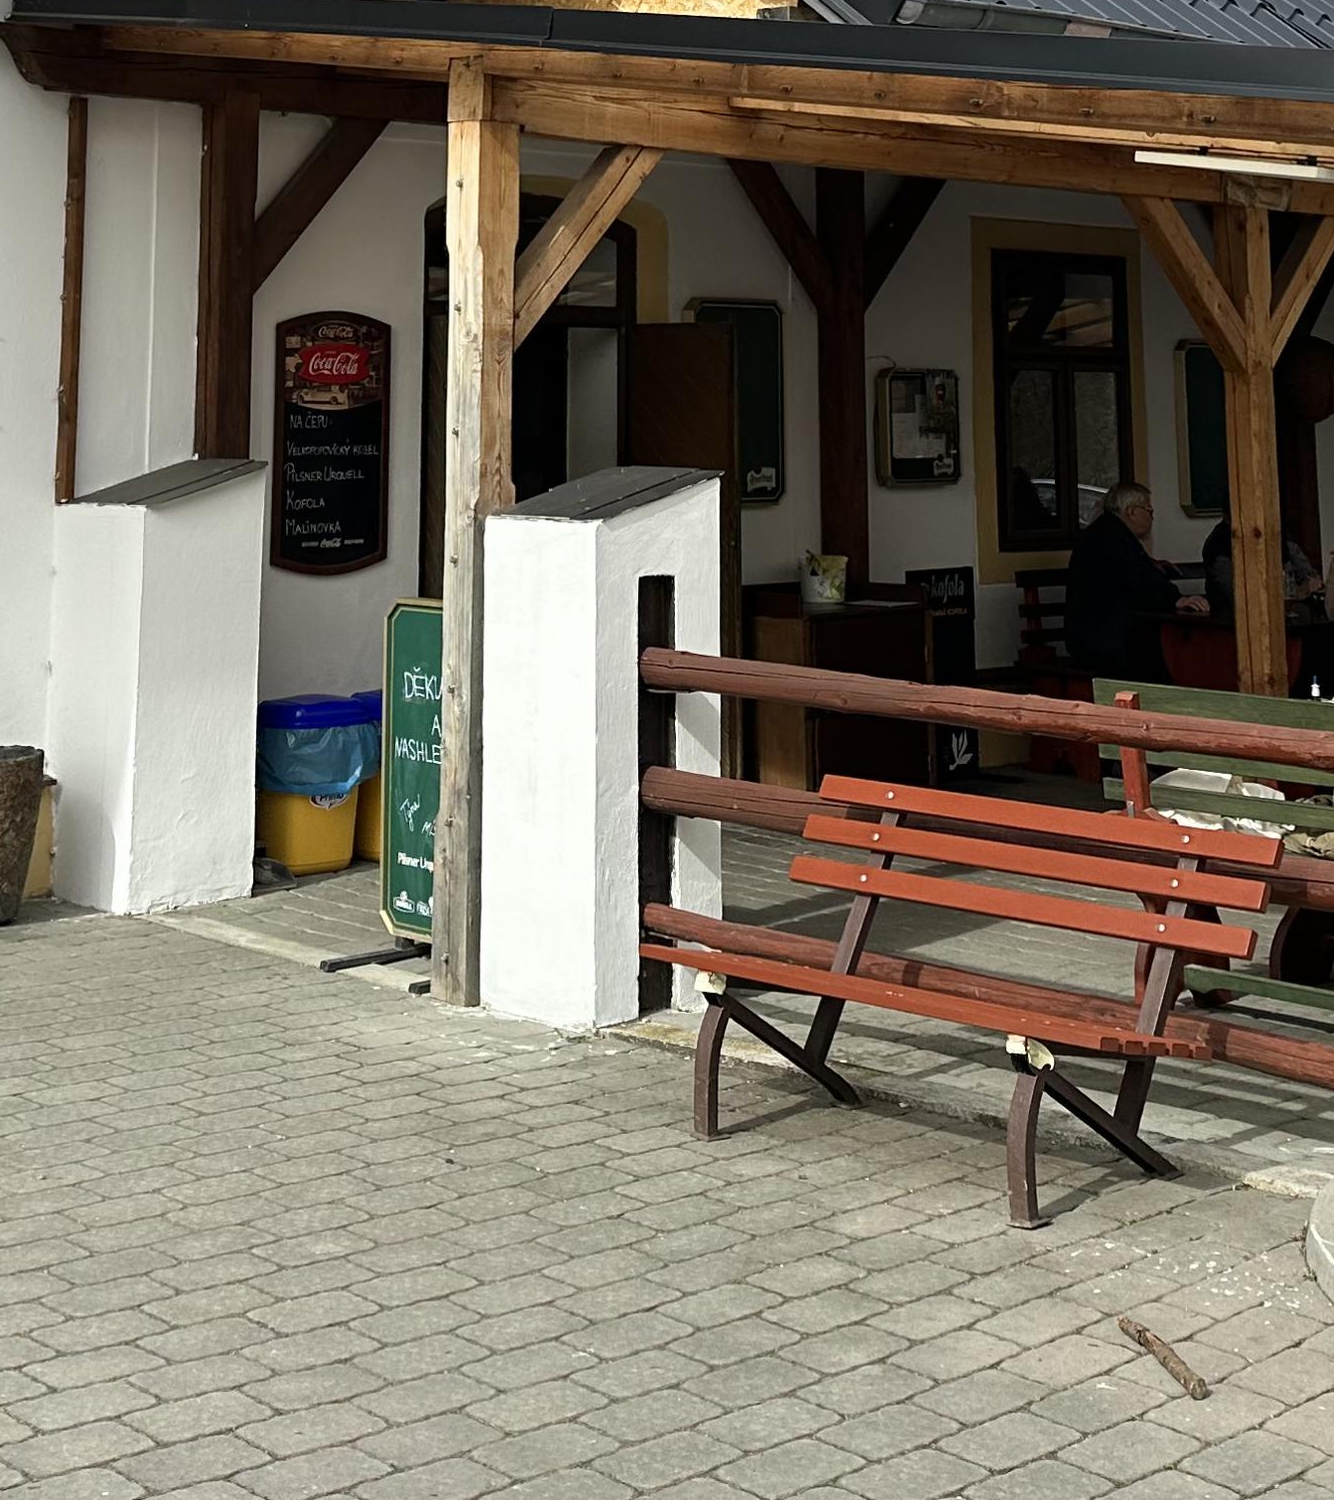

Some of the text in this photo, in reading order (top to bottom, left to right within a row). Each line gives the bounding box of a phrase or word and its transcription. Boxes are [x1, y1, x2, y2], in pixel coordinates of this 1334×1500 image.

[308, 351, 359, 376] Coca-Cola
[290, 414, 303, 429] NA
[403, 666, 443, 701] DĚKU
[431, 714, 442, 738] A
[394, 736, 442, 765] NASHLE
